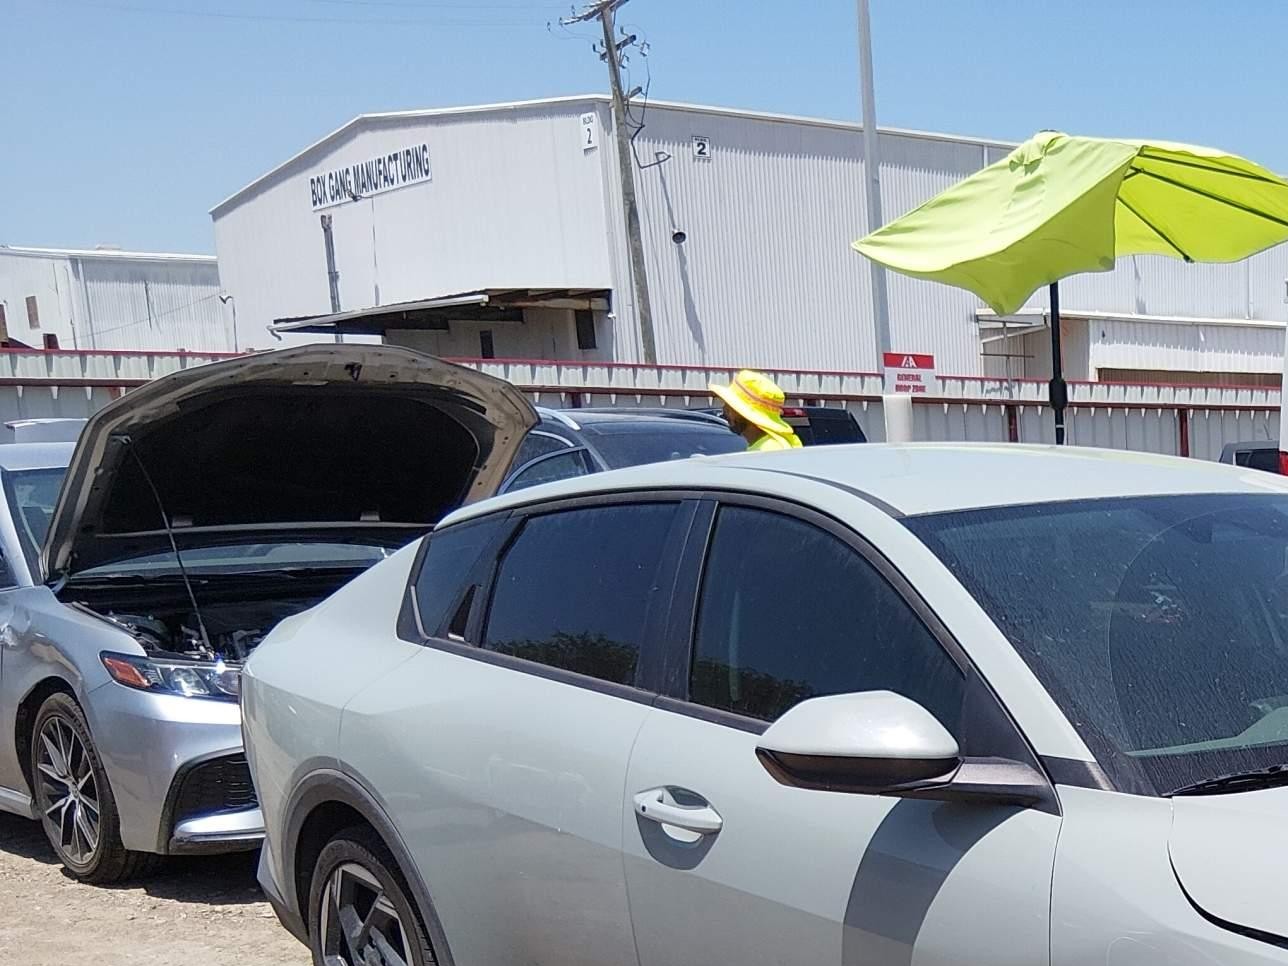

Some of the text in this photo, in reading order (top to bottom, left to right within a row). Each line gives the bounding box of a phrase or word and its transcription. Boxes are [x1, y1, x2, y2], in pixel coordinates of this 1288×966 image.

[696, 142, 707, 156] 2
[310, 144, 430, 207] BOX GANG MANUFACTURING
